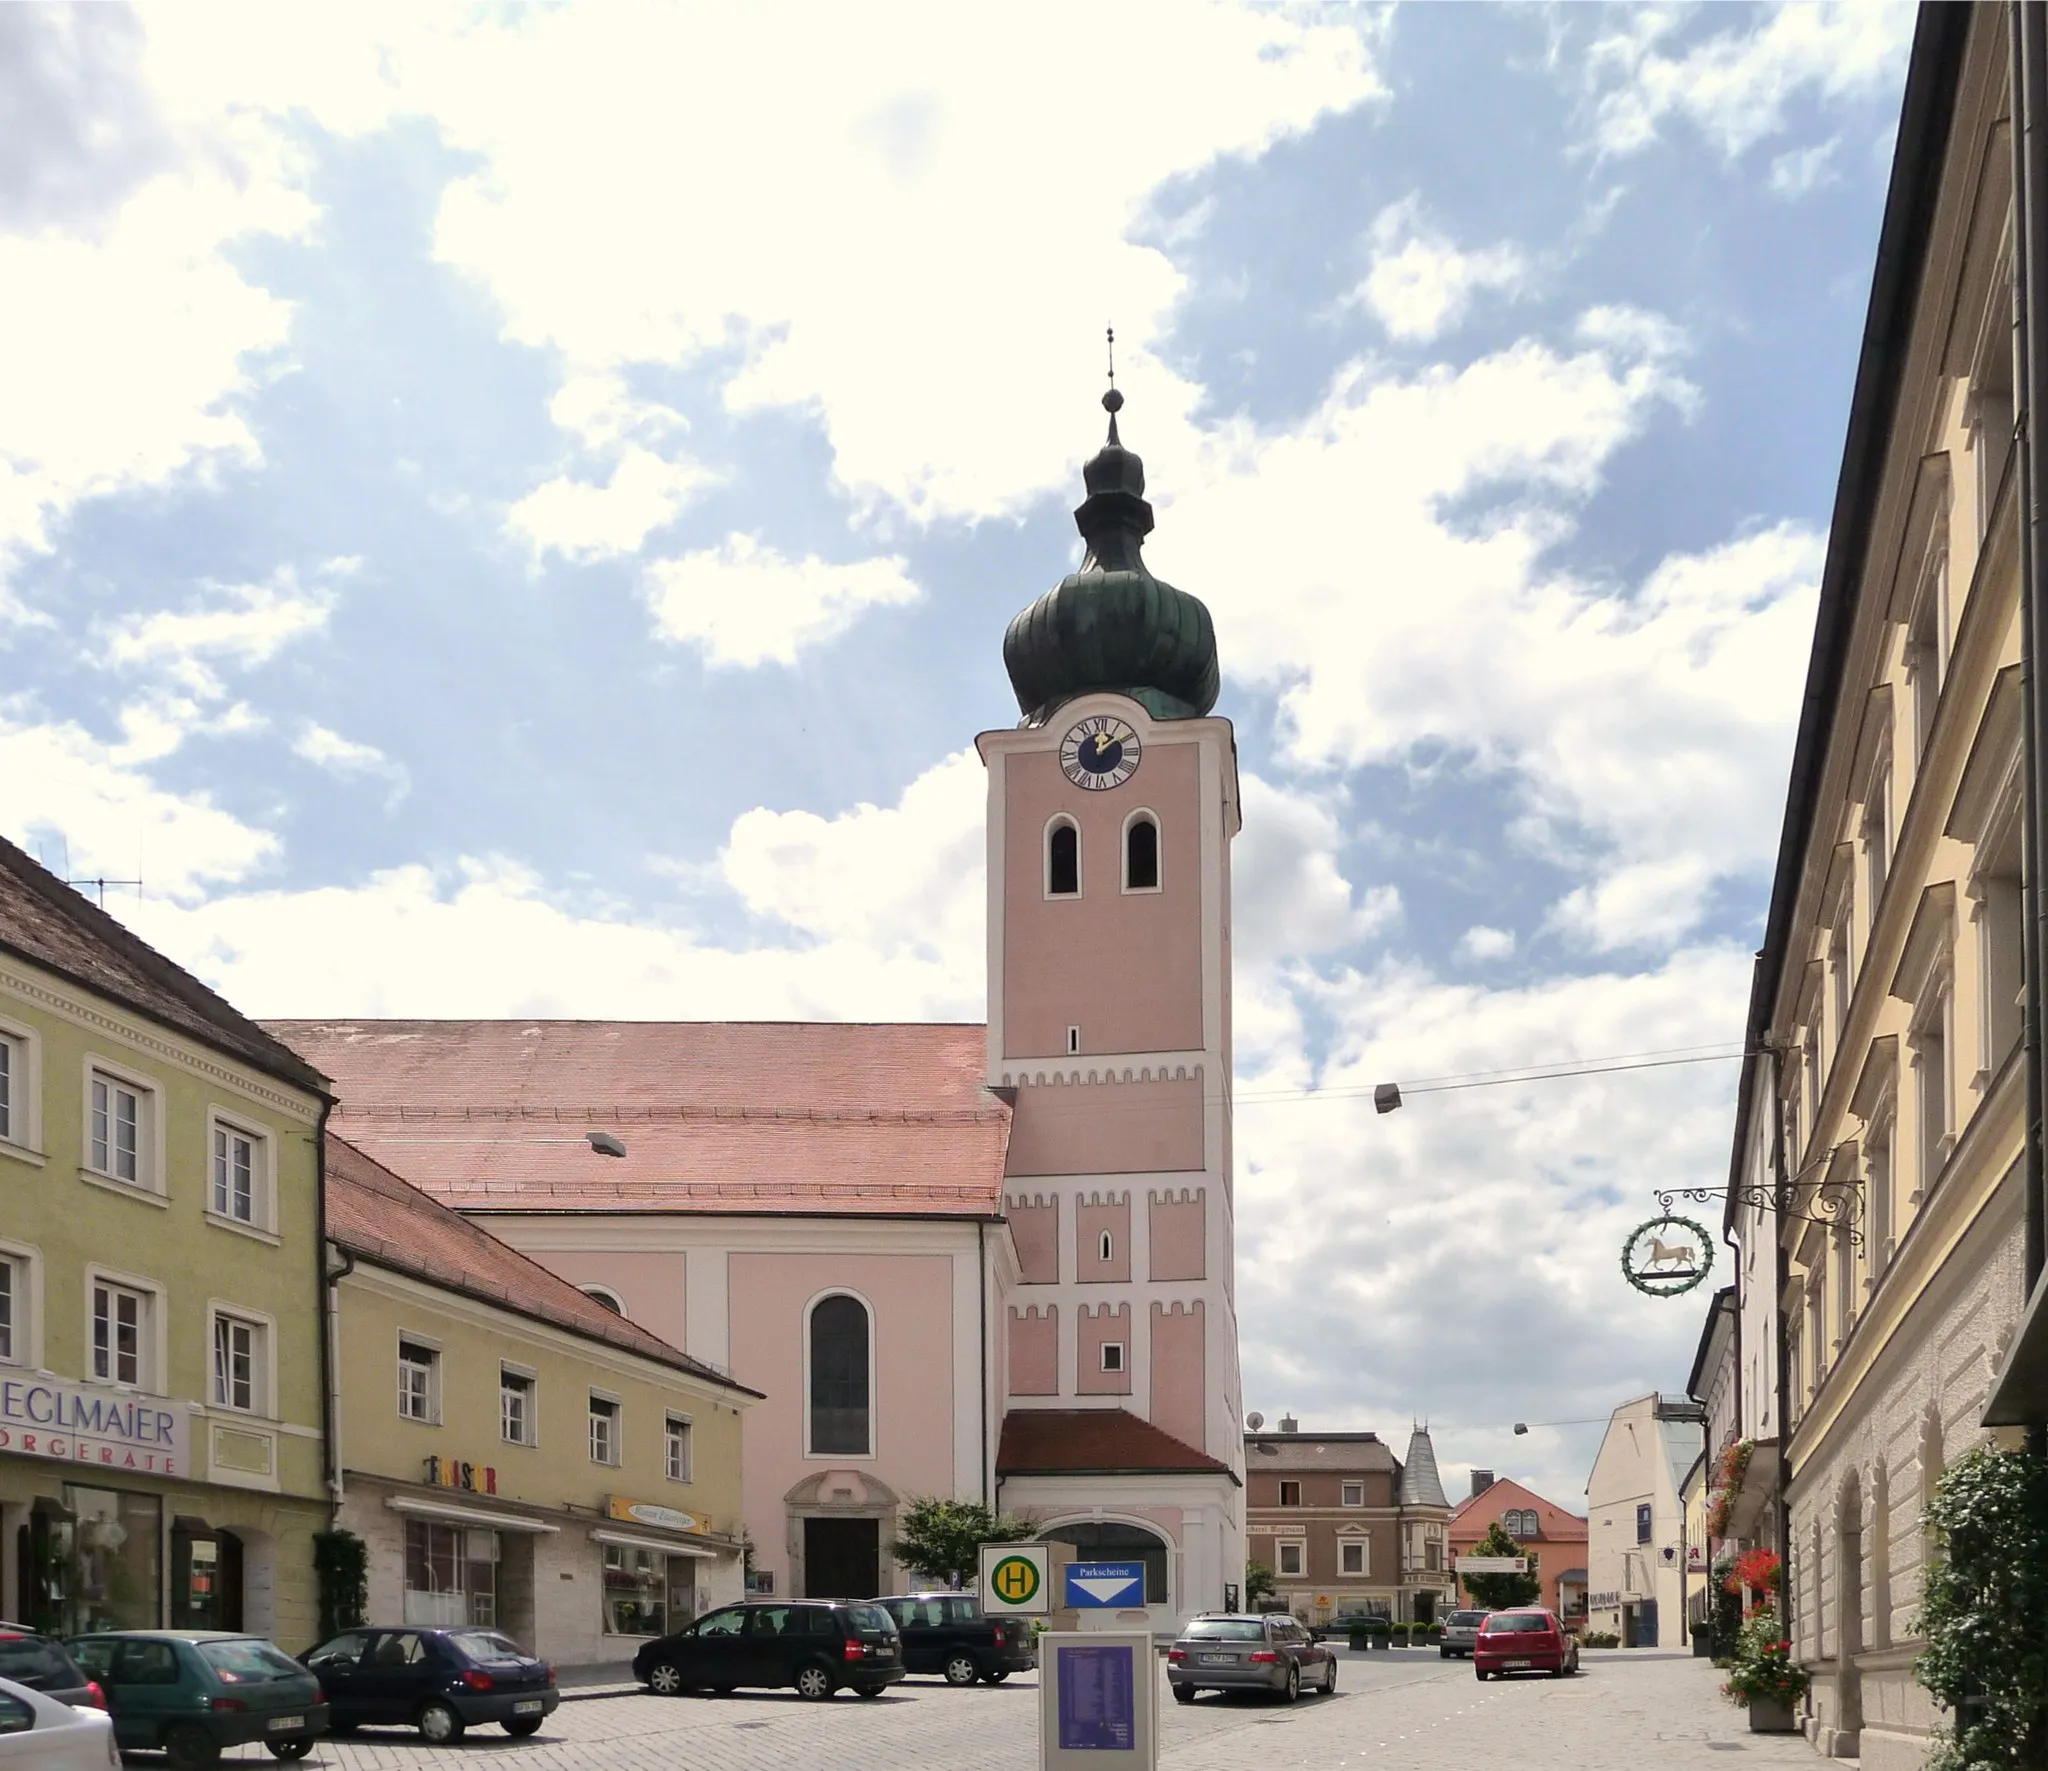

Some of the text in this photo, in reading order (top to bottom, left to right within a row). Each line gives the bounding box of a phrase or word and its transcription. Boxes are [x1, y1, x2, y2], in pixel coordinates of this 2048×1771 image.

[1124, 747, 1138, 756] III
[1080, 1568, 1130, 1577] Parkscheine
[952, 1572, 958, 1586] P
[1006, 1566, 1025, 1594] H
